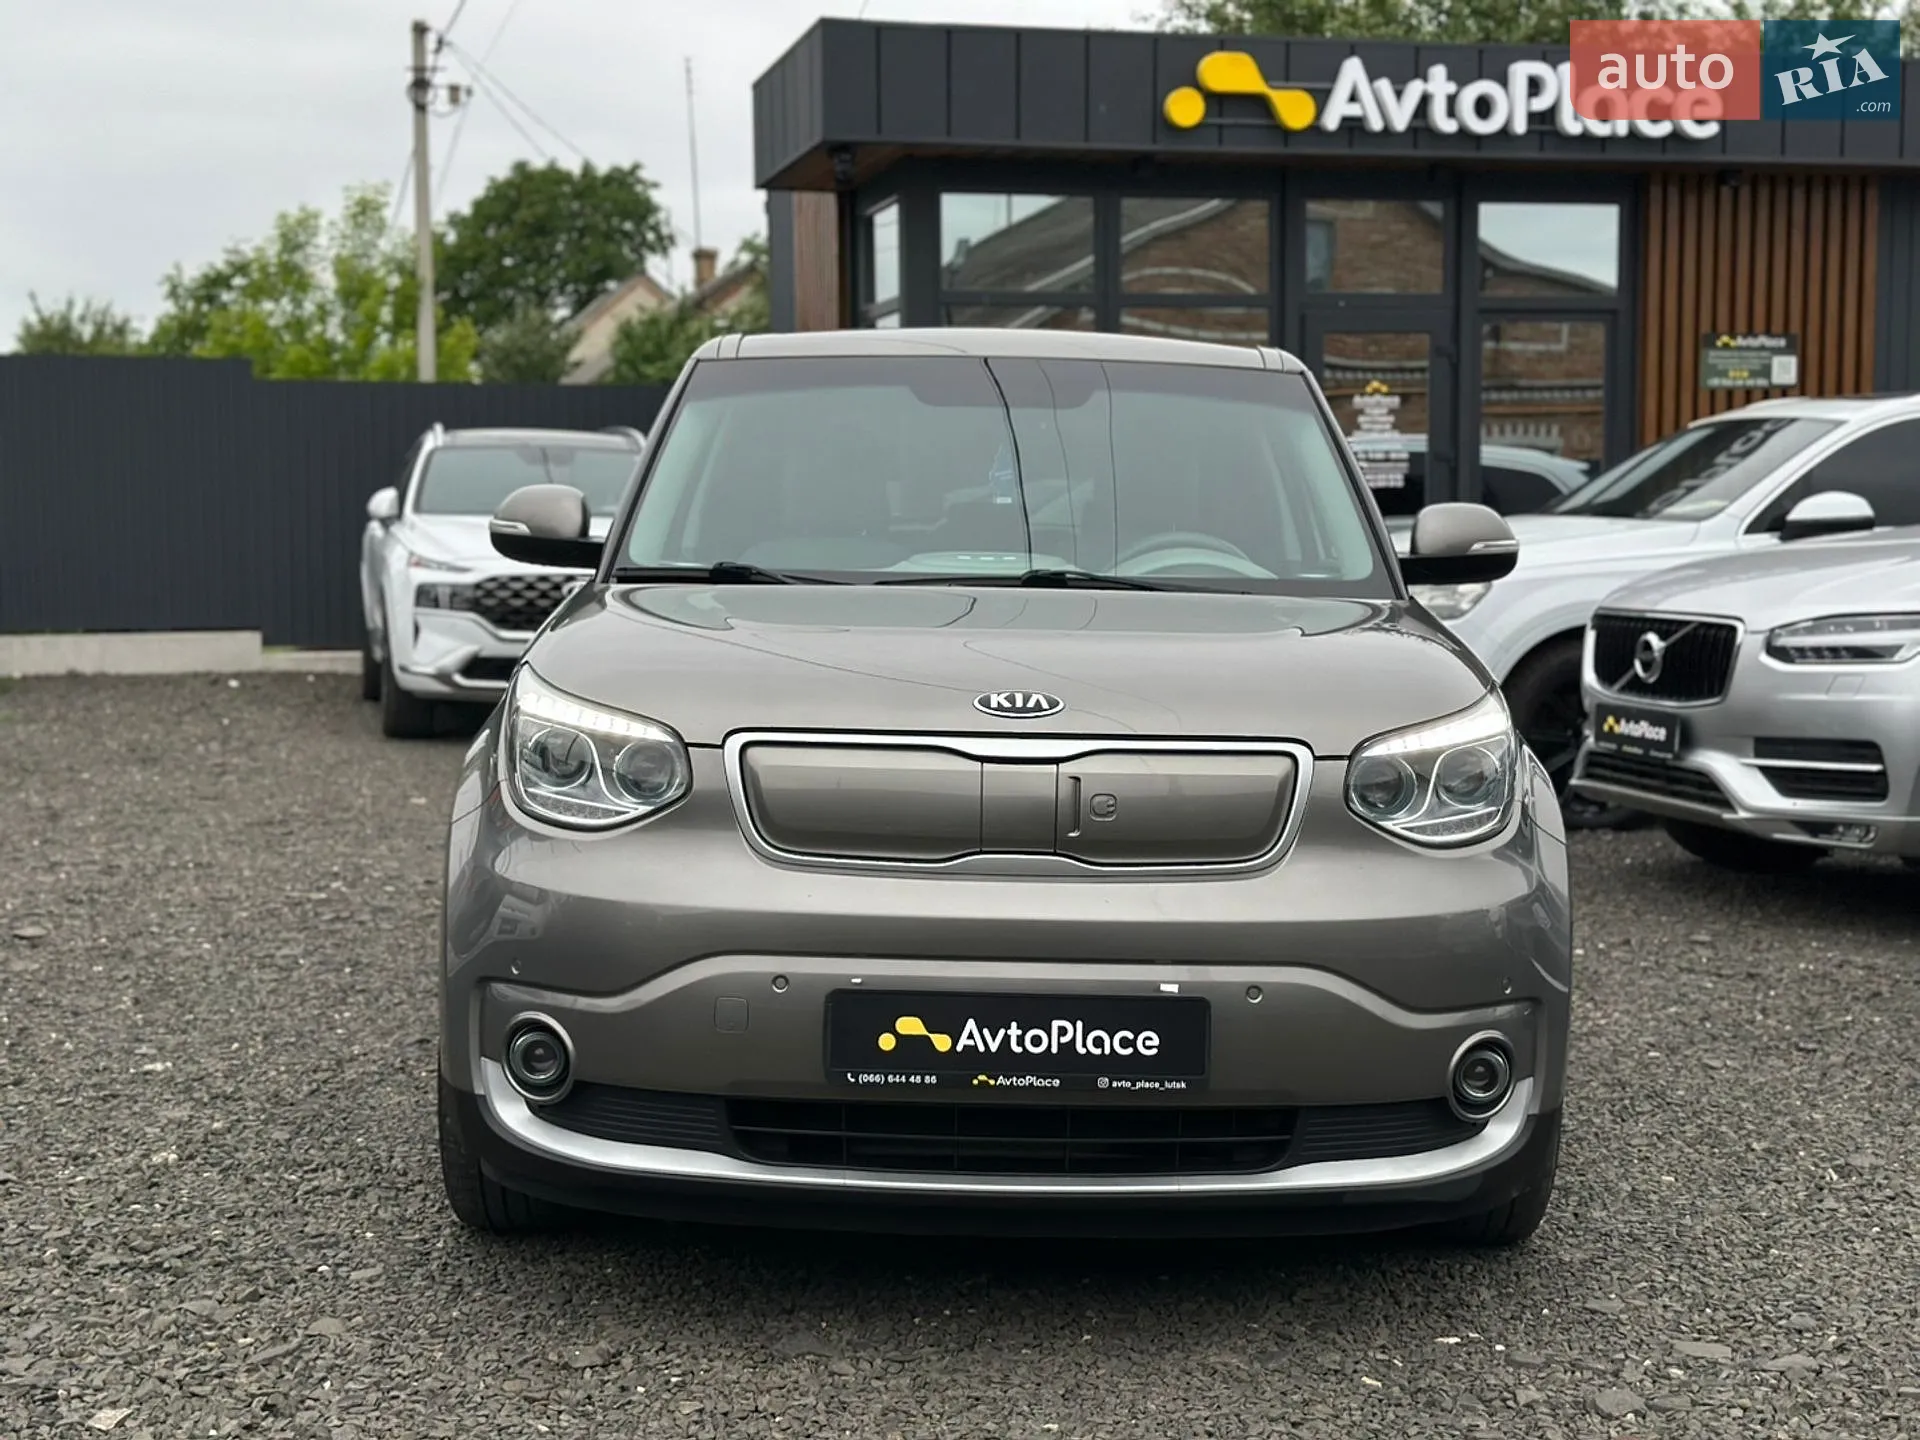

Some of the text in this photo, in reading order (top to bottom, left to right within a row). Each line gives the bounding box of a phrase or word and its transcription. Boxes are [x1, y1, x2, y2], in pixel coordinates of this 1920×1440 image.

[1321, 55, 1724, 139] AvtoPlace
[990, 692, 1050, 709] KIA
[955, 1018, 1160, 1056] AvtoPlace
[858, 1073, 886, 1085] (066)
[887, 1074, 907, 1084] 644
[995, 1074, 1061, 1088] AvtoPlace
